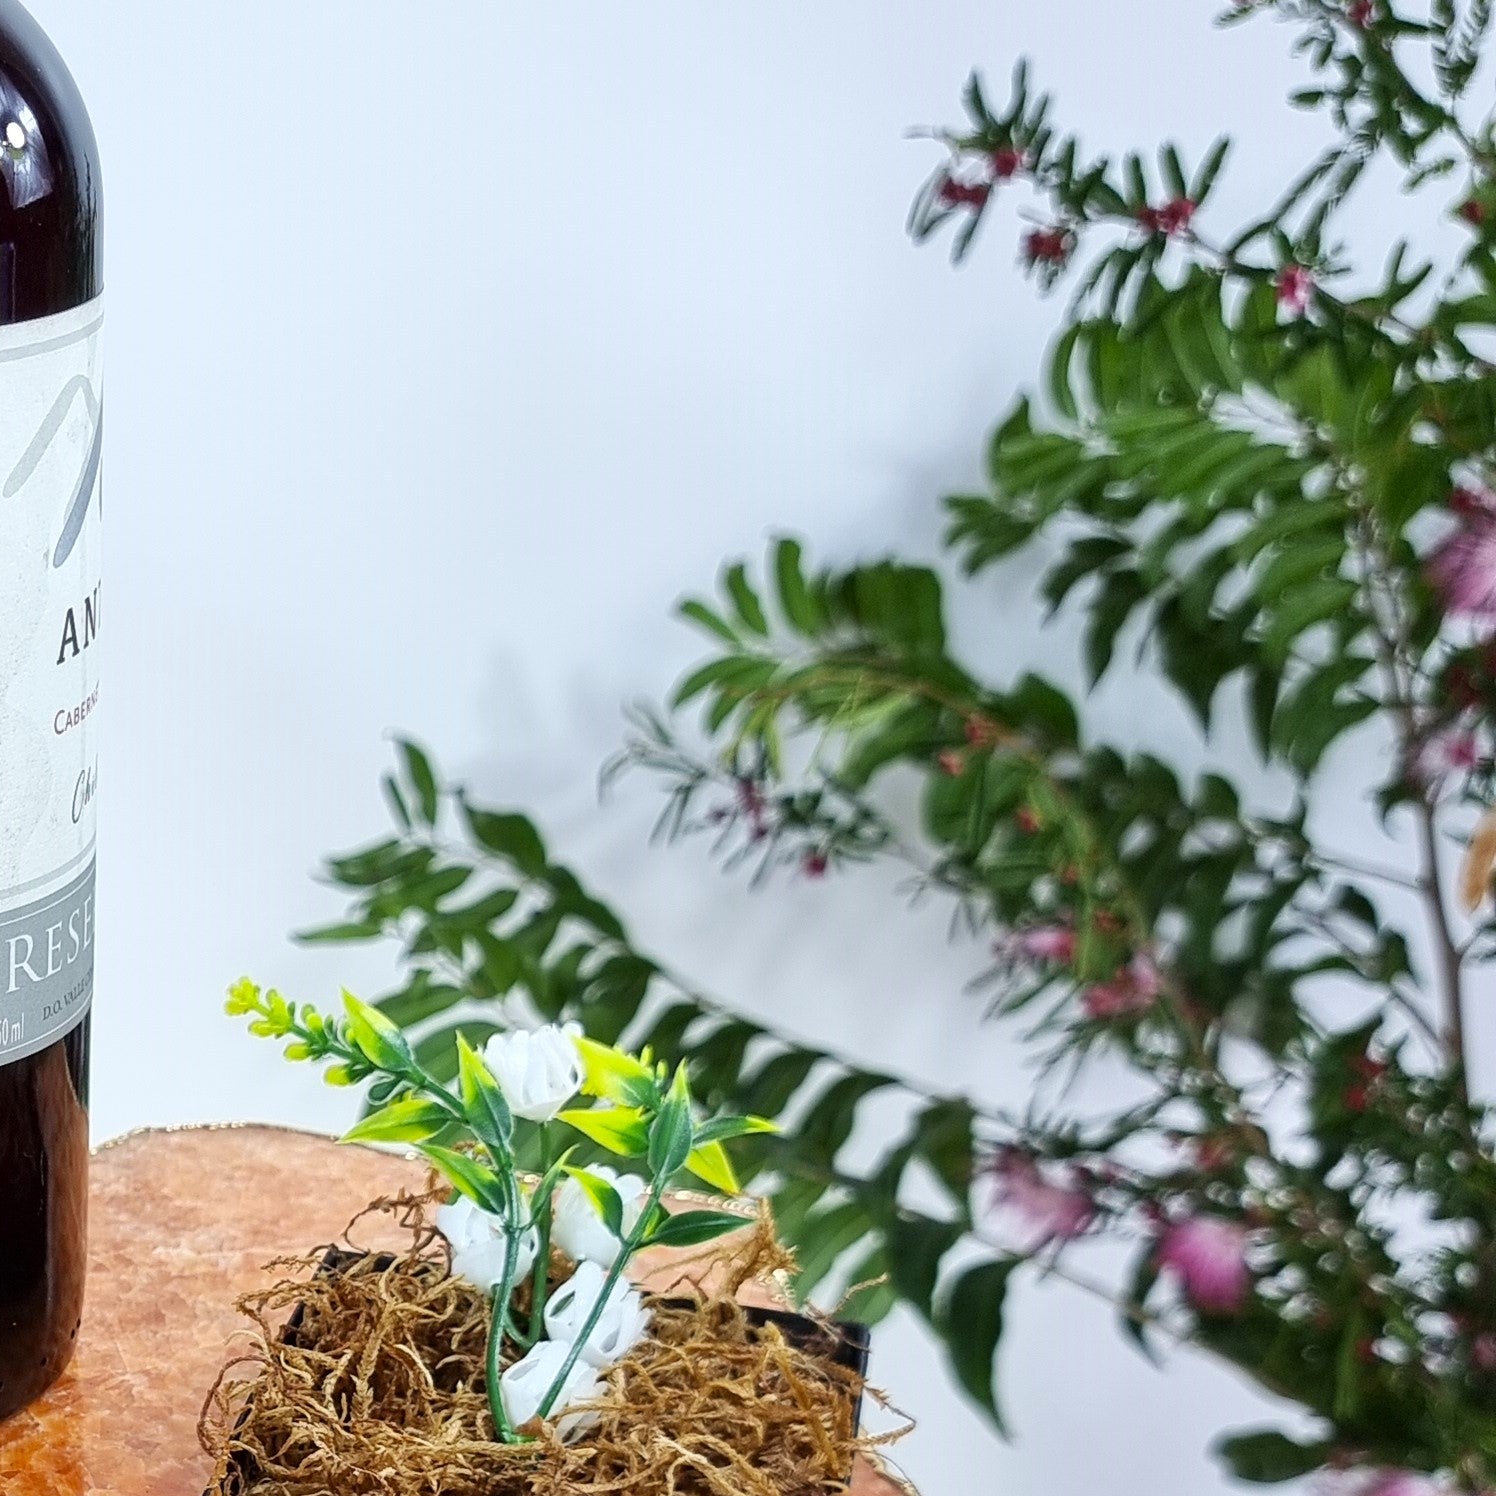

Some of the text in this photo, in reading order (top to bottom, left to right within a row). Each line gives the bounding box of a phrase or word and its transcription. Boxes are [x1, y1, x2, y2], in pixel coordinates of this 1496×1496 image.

[57, 578, 101, 666] AN
[54, 679, 100, 735] CABERN
[5, 893, 93, 994] RESE
[10, 1012, 25, 1044] ml
